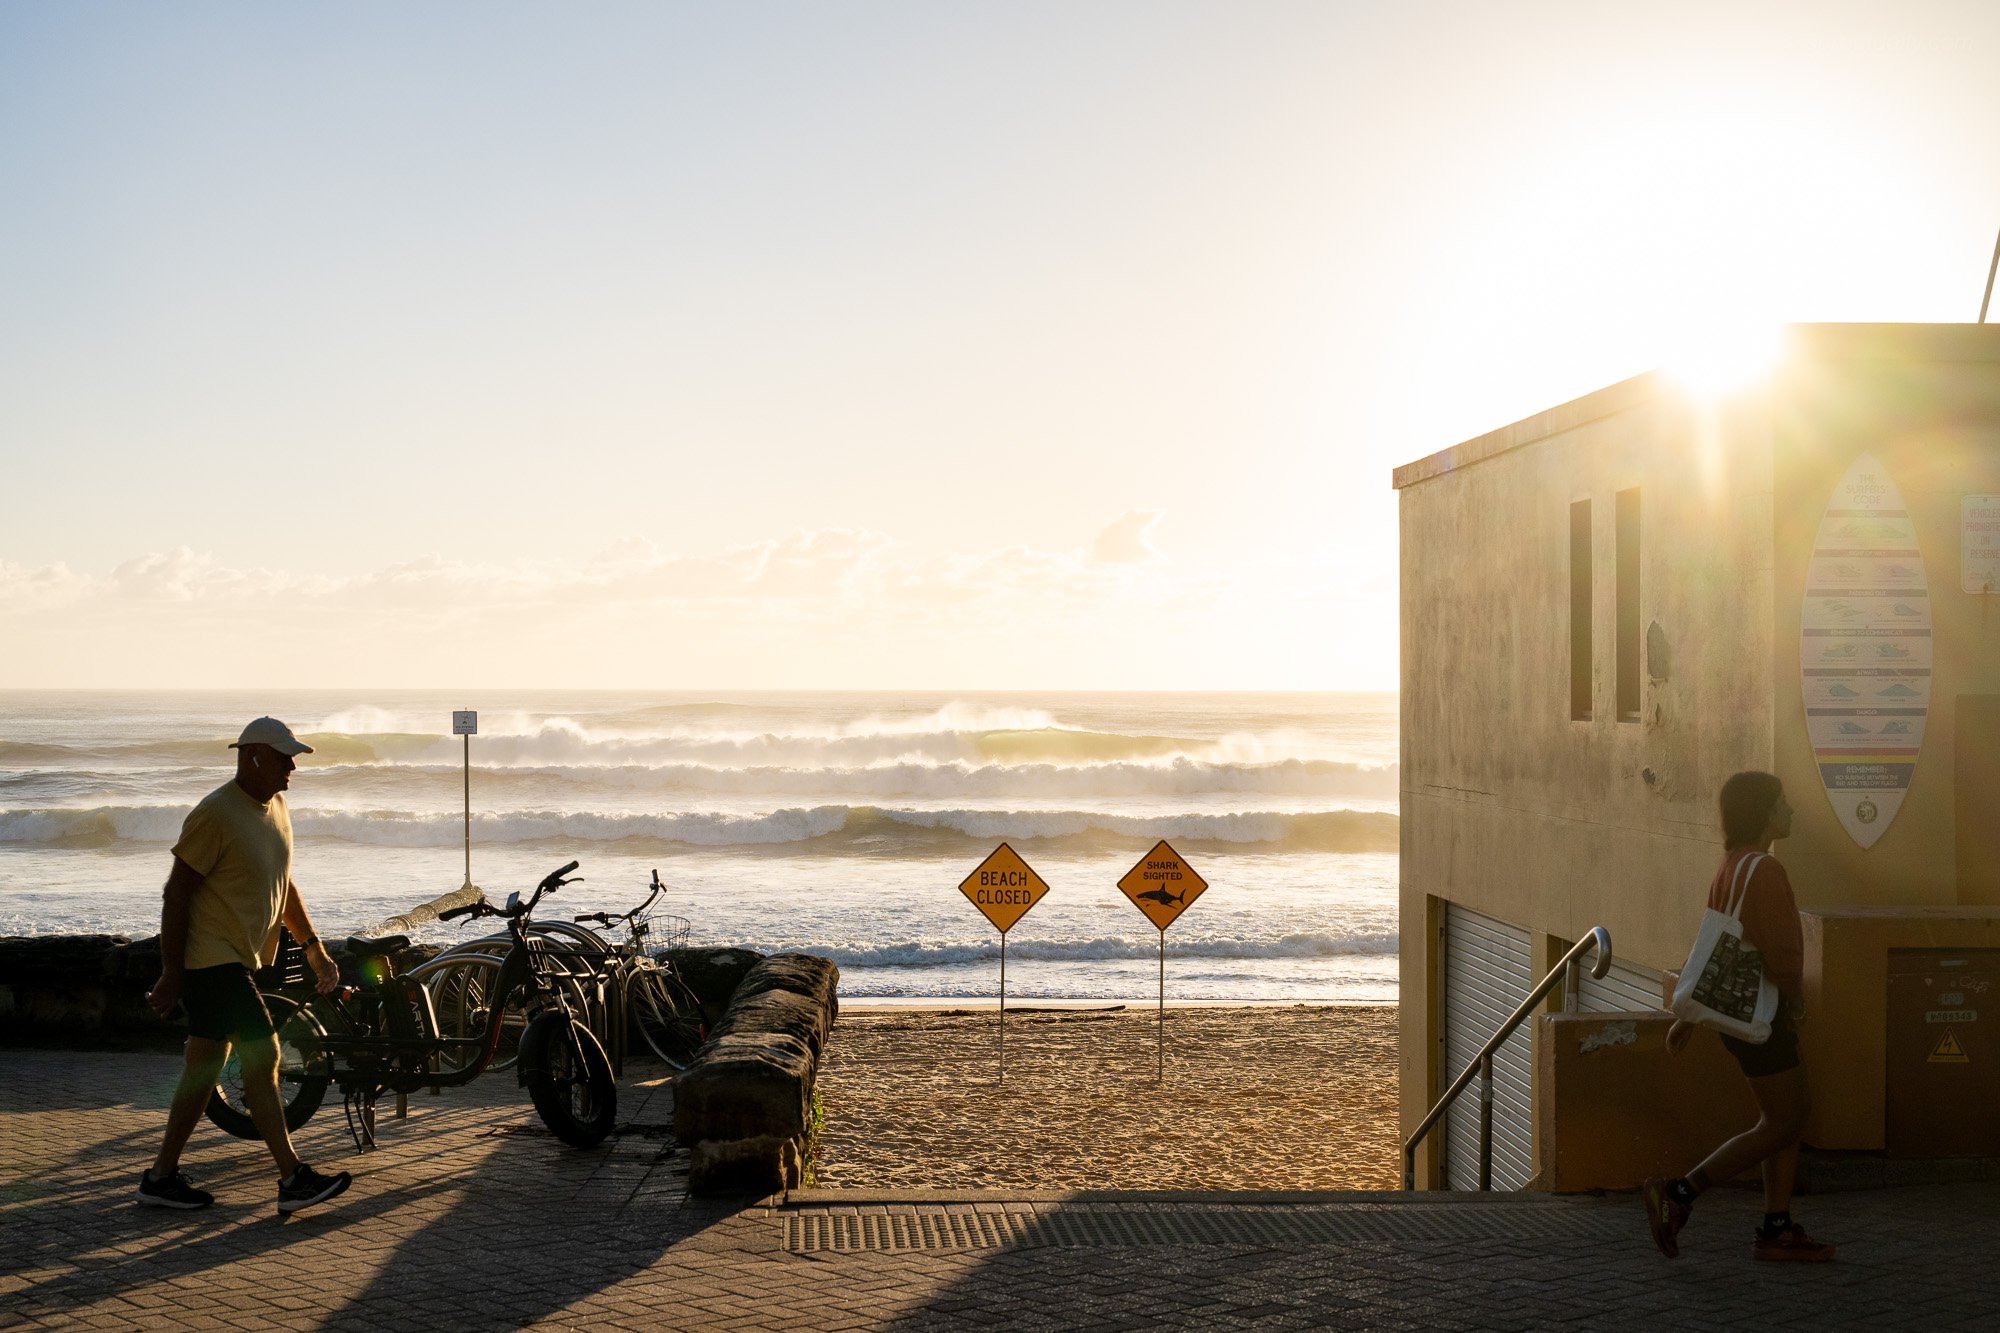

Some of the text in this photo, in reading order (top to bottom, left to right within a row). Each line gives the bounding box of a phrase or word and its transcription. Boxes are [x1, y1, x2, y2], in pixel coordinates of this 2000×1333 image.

[1859, 474, 1876, 484] THE
[1853, 495, 1881, 505] CODE
[1147, 861, 1179, 870] SHARK
[981, 871, 1027, 886] BEACH
[1143, 871, 1182, 880] SIGHTED
[977, 889, 1031, 905] CLOSED
